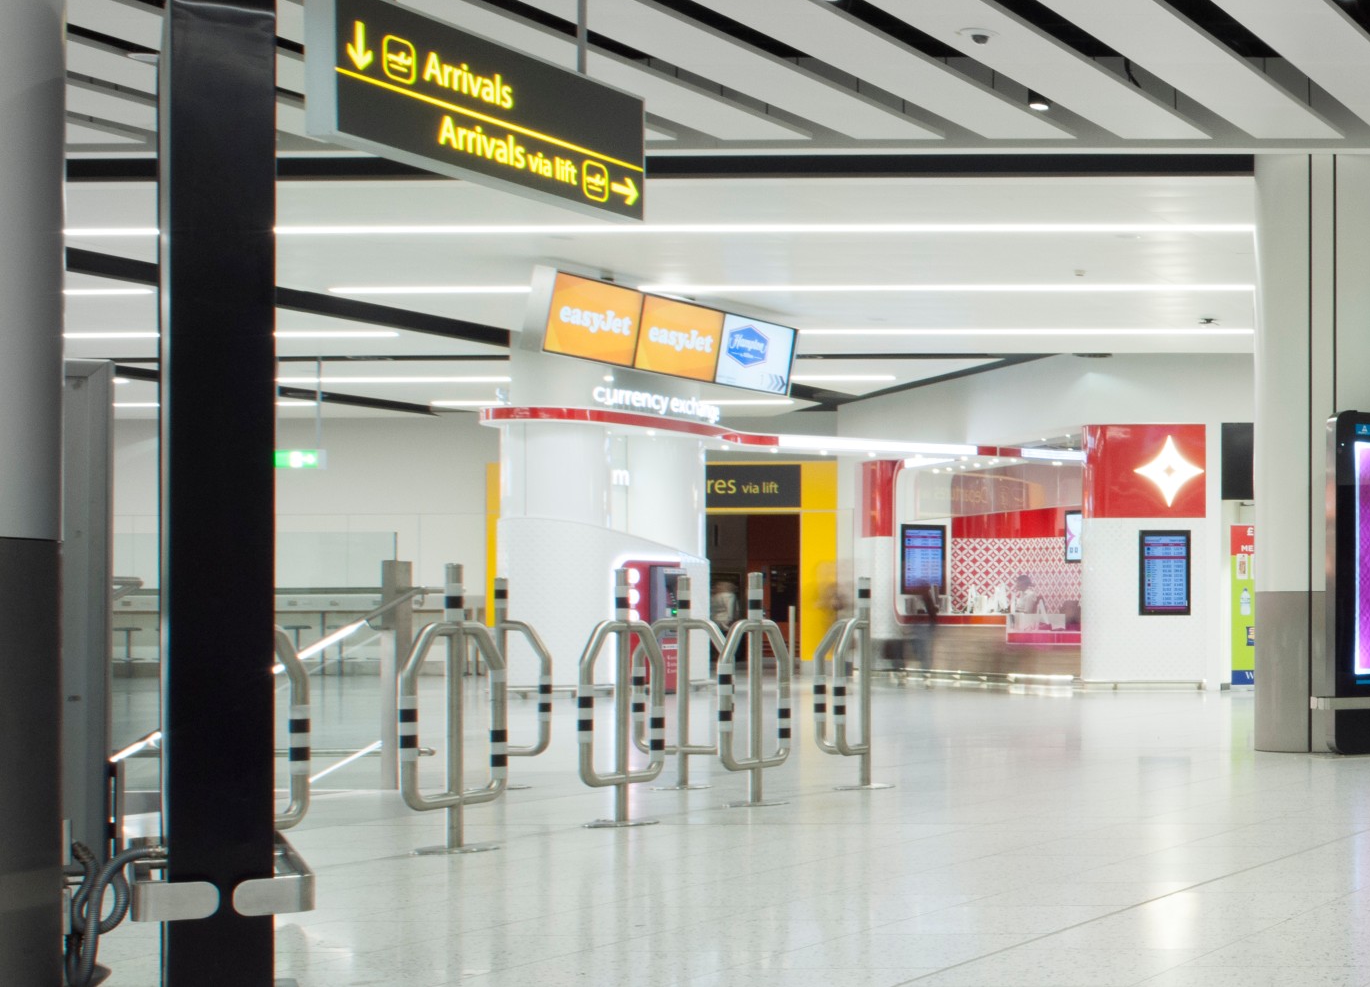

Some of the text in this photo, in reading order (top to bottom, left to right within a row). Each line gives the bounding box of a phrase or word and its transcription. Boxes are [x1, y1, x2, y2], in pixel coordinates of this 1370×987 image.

[423, 51, 514, 109] Arrivals
[438, 115, 578, 186] Arrivals via lift
[560, 306, 633, 336] easyJet
[648, 325, 714, 353] easyJet
[593, 386, 669, 415] currency
[741, 483, 759, 494] via
[762, 481, 779, 494] lift
